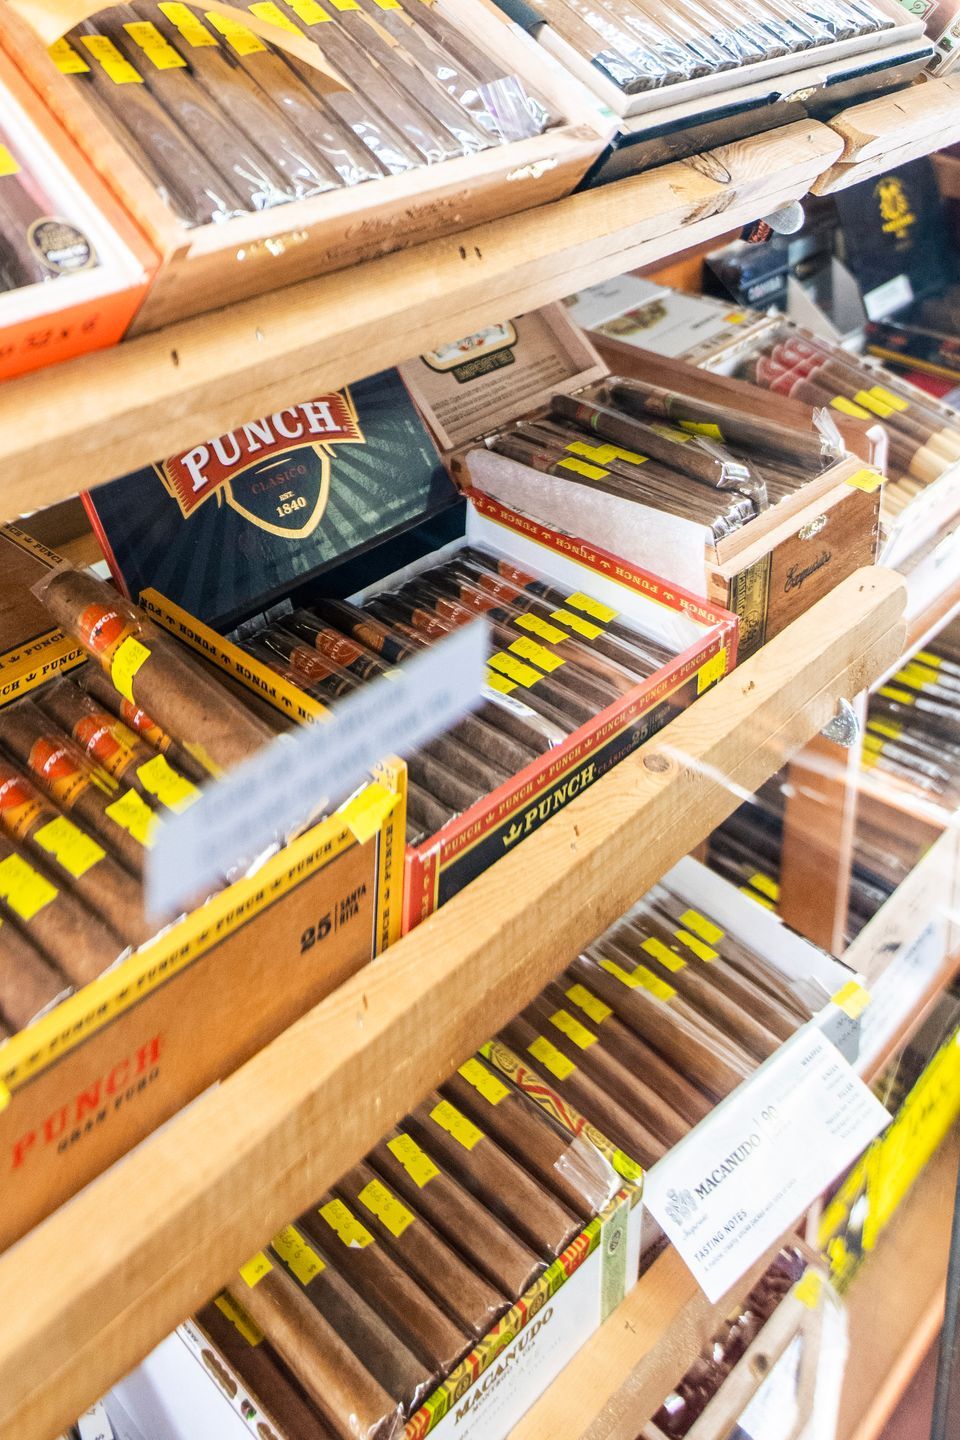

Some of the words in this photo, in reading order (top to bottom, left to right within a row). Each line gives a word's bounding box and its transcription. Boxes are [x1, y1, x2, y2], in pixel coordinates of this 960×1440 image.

[180, 401, 342, 493] PUNCH
[250, 464, 308, 495] CLASICO
[275, 496, 307, 518] 1840
[555, 537, 596, 564] PUNCH
[615, 566, 659, 595] PUNCH
[680, 645, 707, 677] PUNCH
[235, 662, 278, 698] PUNCH
[639, 680, 668, 708] PUNCH
[596, 713, 628, 742] PUNCH
[549, 748, 582, 776] PUNCH
[498, 782, 535, 816] PUNCH
[524, 762, 595, 835] PUNCH
[444, 819, 483, 856] PUNCH
[339, 881, 368, 911] SANTA
[339, 902, 360, 926] RITA
[299, 911, 333, 955] 25
[10, 1035, 162, 1170] PUNCH
[693, 1132, 762, 1201] MACANUDO
[694, 1230, 725, 1264] TASTING
[723, 1208, 749, 1238] NOTES
[453, 1307, 554, 1426] MACANUDO
